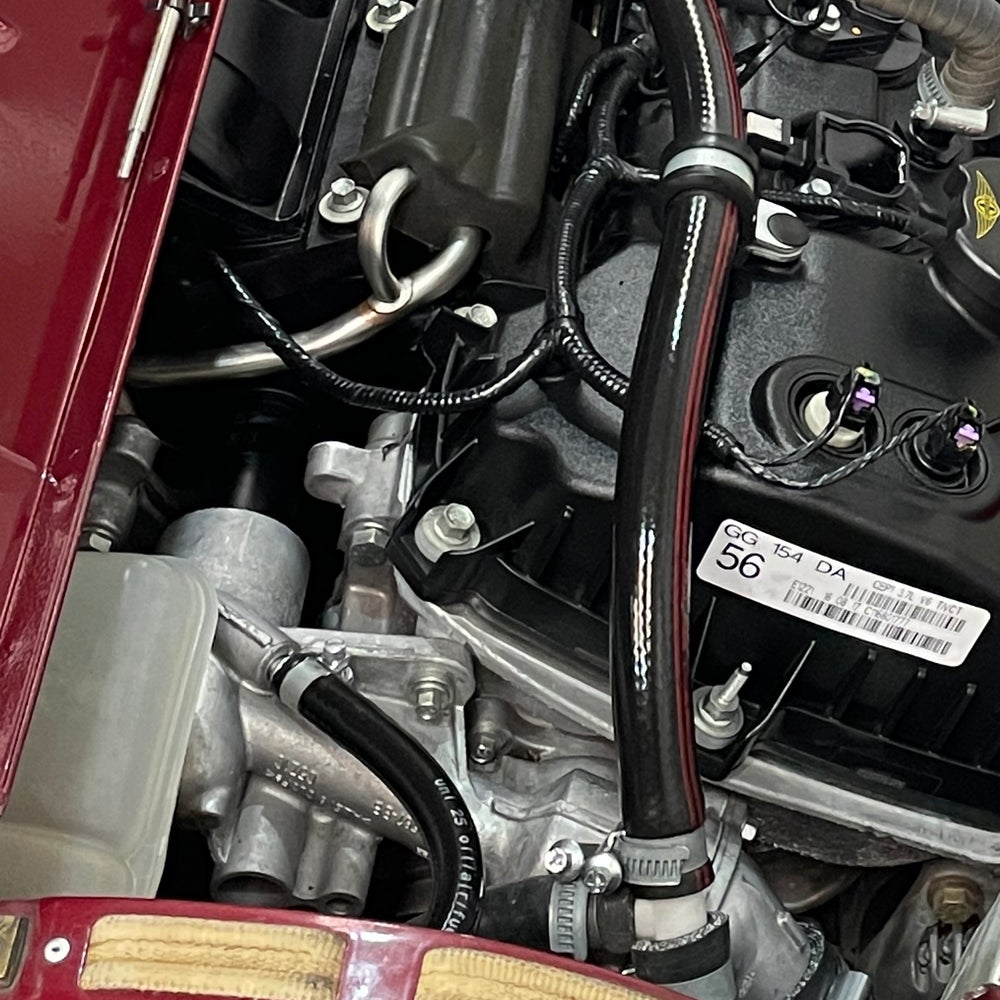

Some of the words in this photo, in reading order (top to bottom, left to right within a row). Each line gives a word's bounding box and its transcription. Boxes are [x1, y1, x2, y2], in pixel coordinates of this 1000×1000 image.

[716, 542, 765, 579] 56
[724, 524, 759, 546] GG
[773, 543, 803, 564] 154
[815, 560, 846, 581] DA
[450, 808, 468, 827] 25
